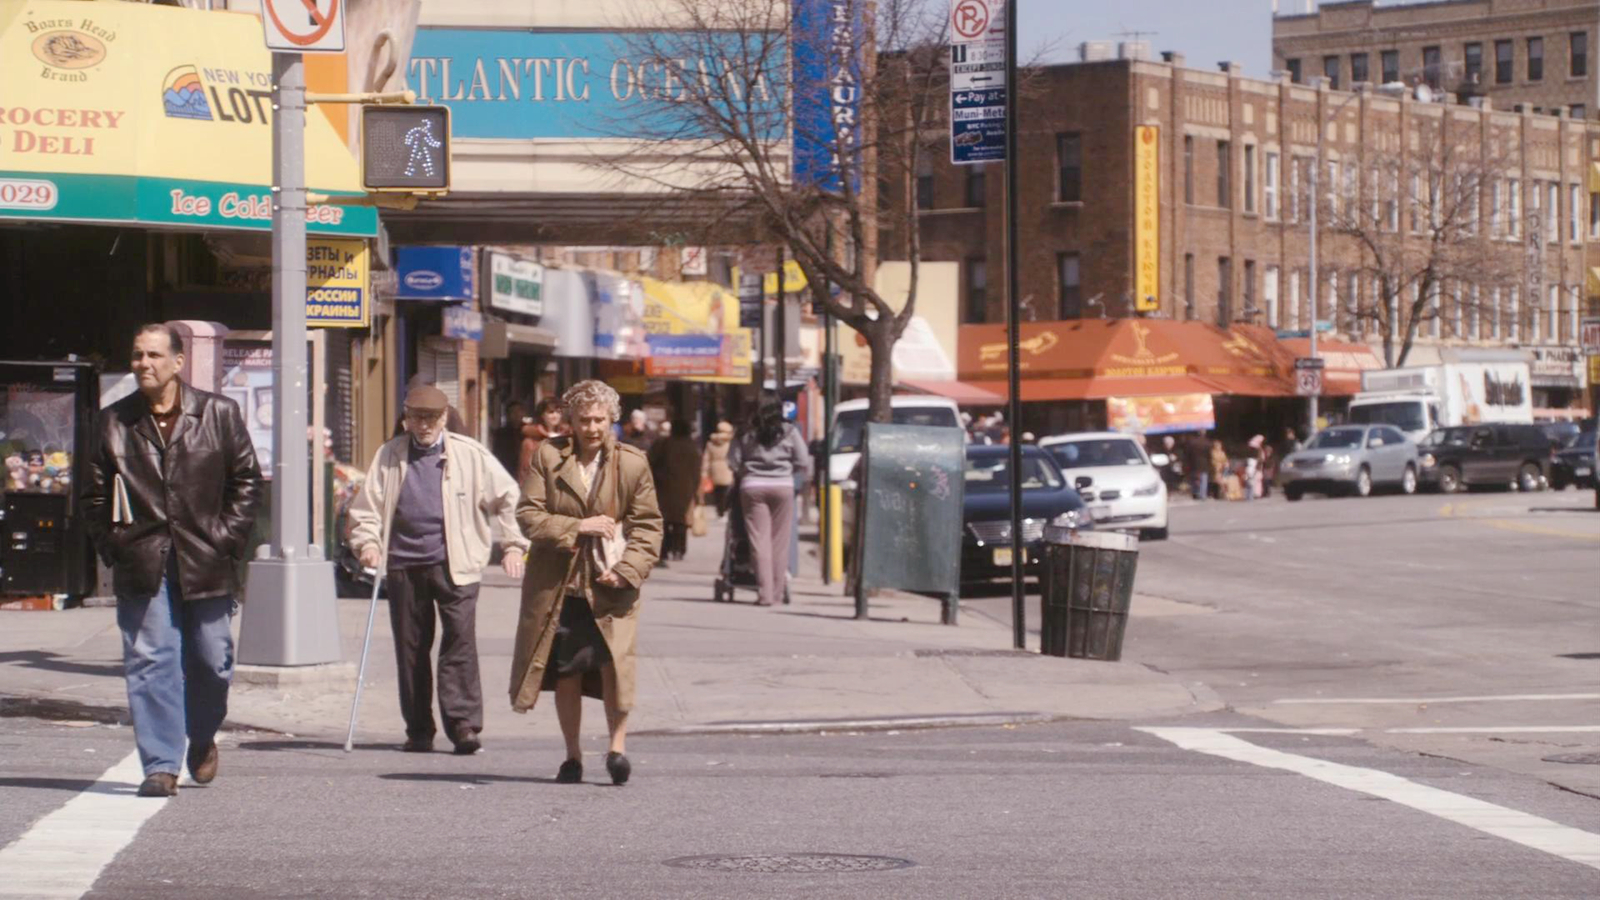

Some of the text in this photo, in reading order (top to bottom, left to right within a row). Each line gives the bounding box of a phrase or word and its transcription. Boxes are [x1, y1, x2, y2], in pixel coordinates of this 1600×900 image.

[80, 19, 116, 42] Head
[40, 66, 88, 82] Brand
[203, 67, 240, 84] NEW
[404, 56, 590, 101] TLANTIC
[968, 92, 999, 104] Pay at
[0, 106, 125, 128] OCERY
[1, 184, 51, 204] 029
[171, 191, 343, 225] Ice Cold eer
[306, 247, 340, 261] ЗЕТЫ
[306, 266, 358, 280] РНАЛЫ
[306, 304, 360, 317] КРАИНЫ
[222, 349, 261, 358] RELEASE
[222, 359, 243, 367] RIDAY
